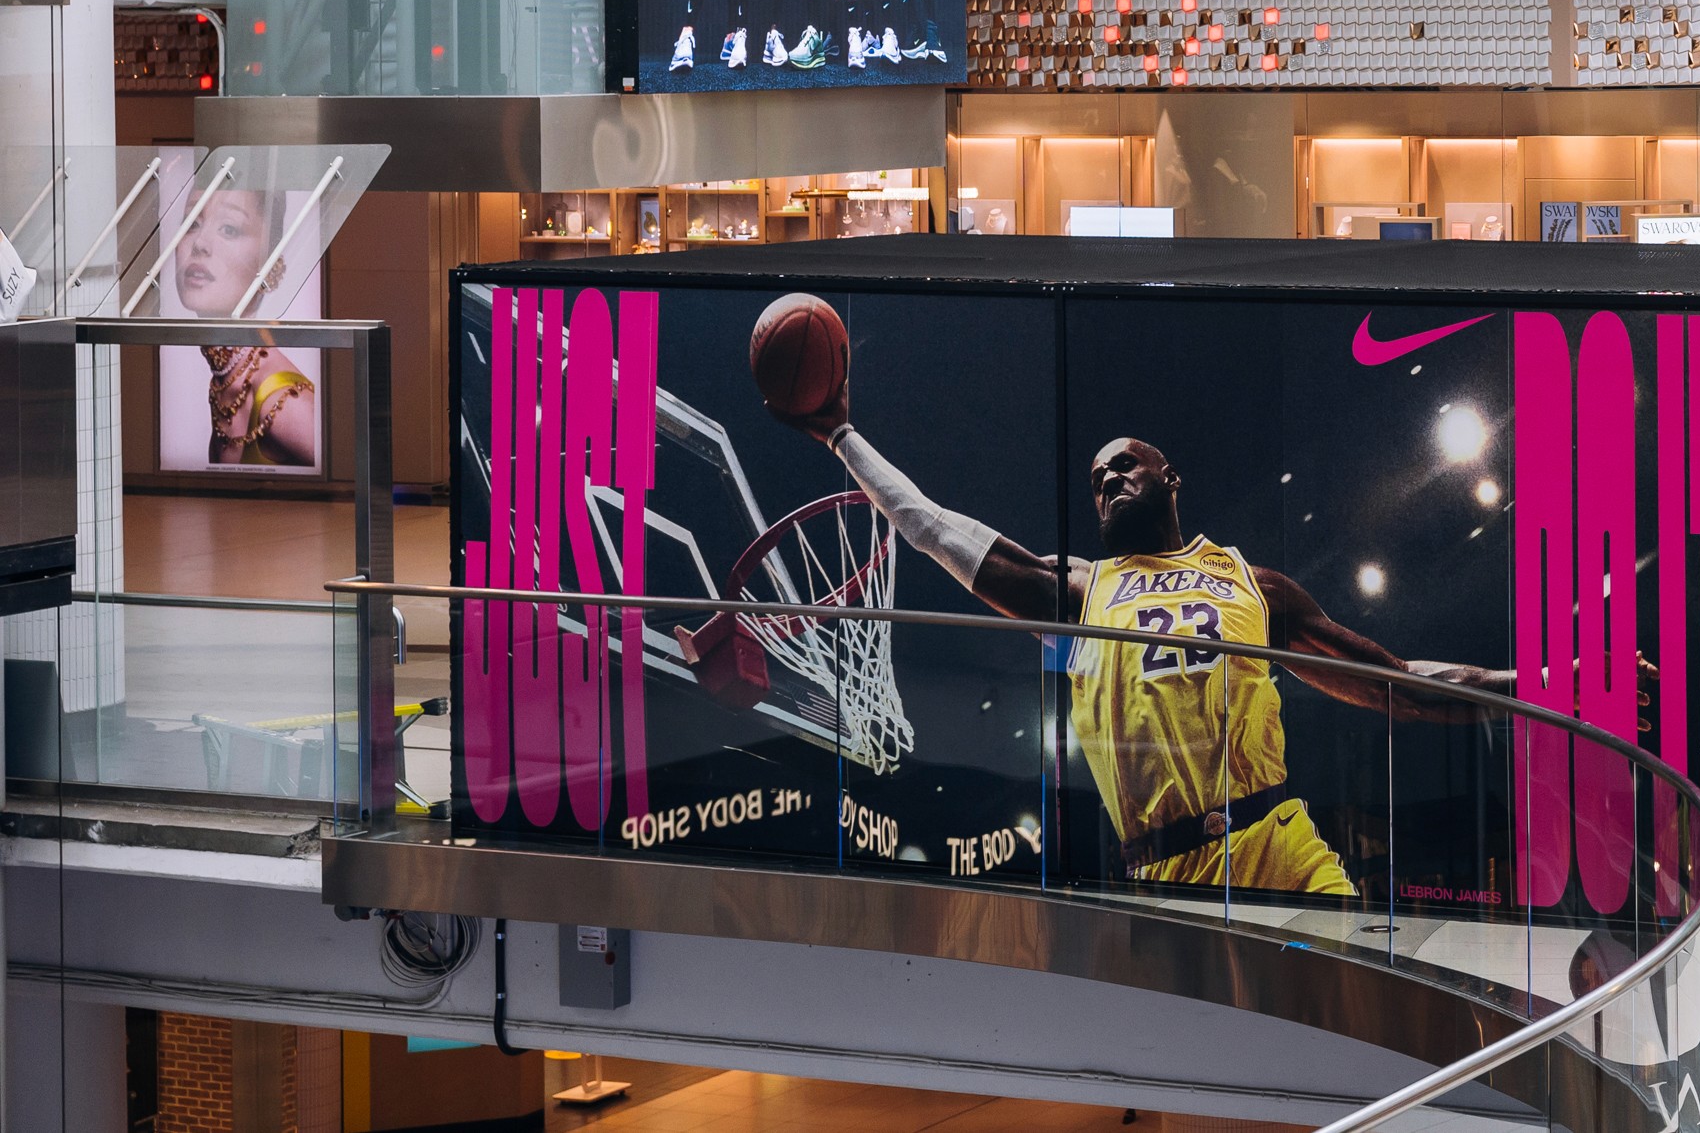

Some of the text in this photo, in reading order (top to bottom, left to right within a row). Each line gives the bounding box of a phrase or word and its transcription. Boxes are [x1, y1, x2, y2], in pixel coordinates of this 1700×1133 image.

[2, 267, 21, 305] SUZY
[462, 287, 660, 831] JUST
[1202, 558, 1234, 571] bibigo
[1105, 569, 1235, 610] LAKERS
[1513, 310, 1637, 915] DO
[1136, 601, 1224, 679] 23
[857, 805, 898, 861] SHOP
[946, 836, 978, 877] THE
[1400, 884, 1502, 905] LEBRON JAMES
